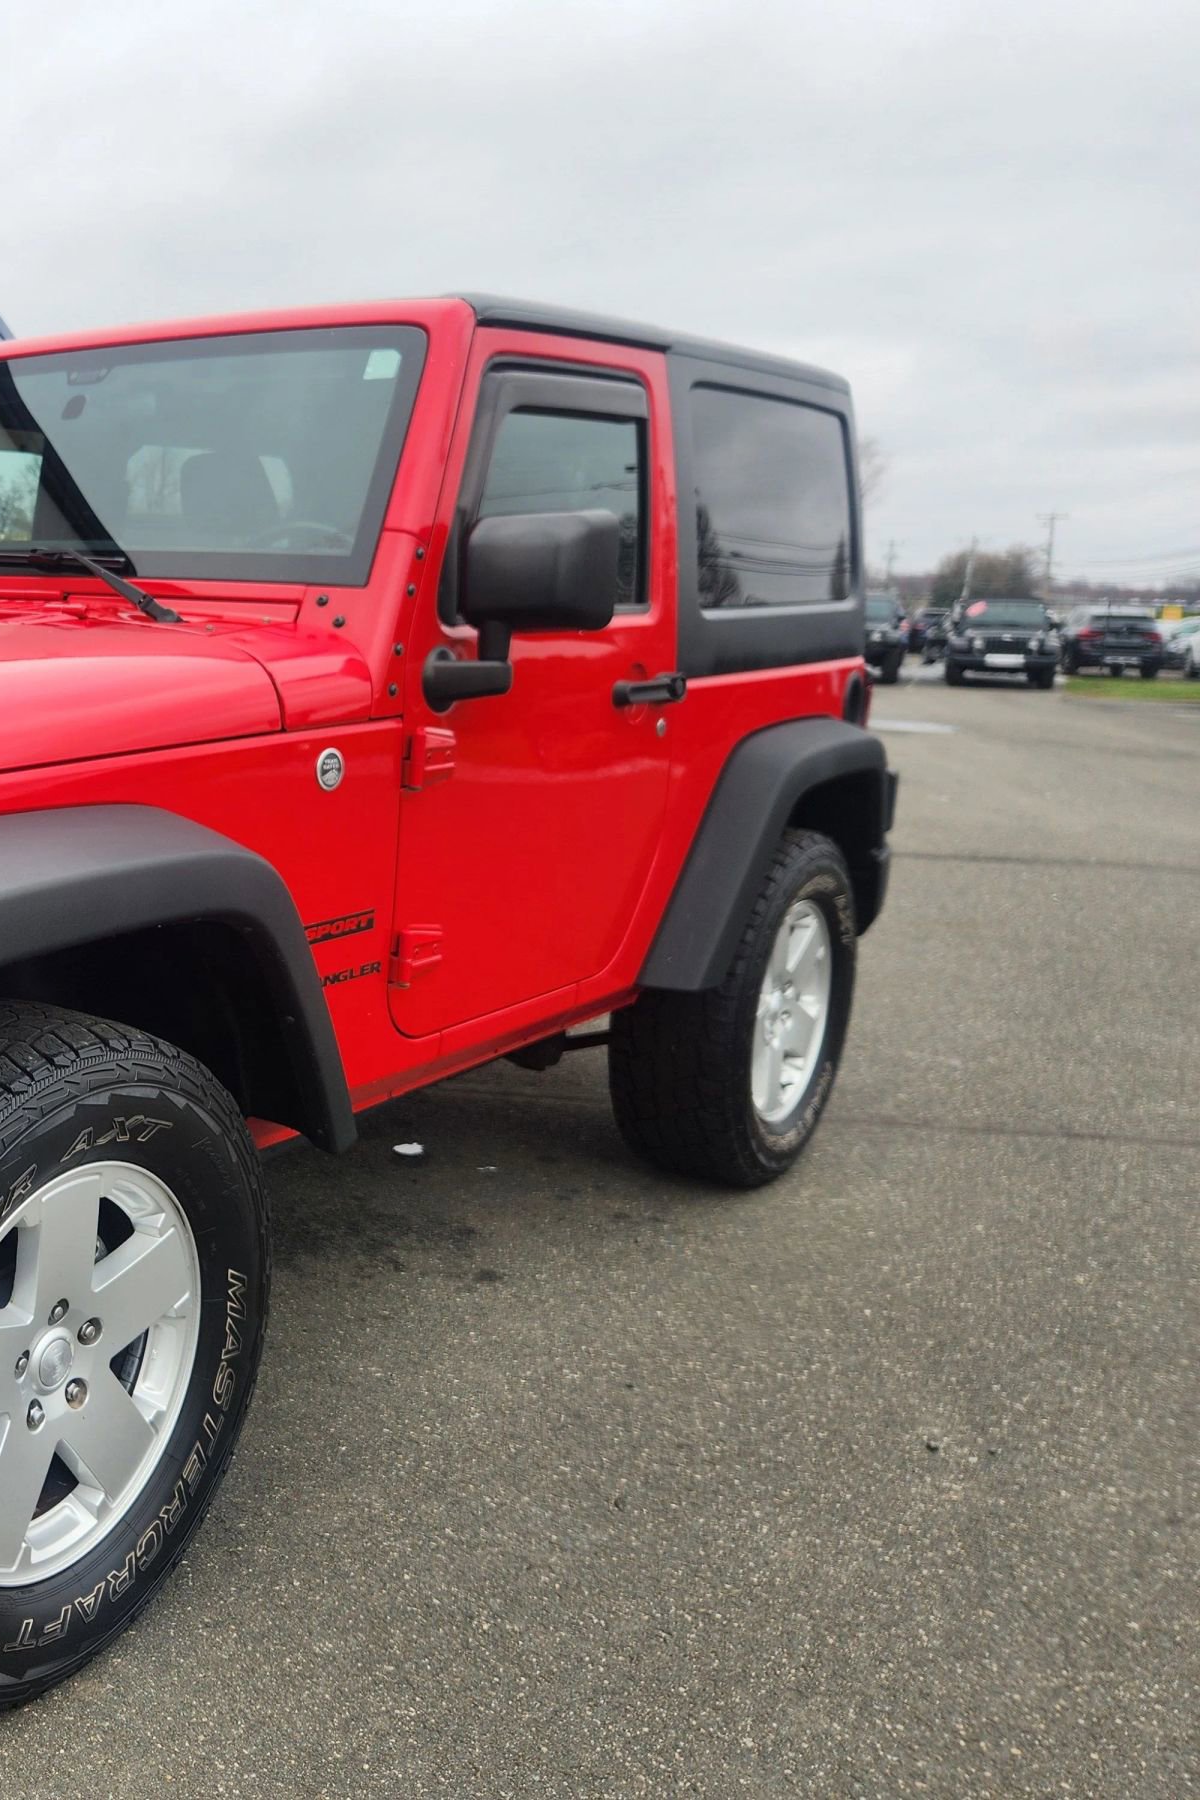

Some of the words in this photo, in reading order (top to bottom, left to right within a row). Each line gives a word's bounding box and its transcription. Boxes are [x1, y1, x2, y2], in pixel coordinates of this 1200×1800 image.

[305, 914, 374, 941] SPORT
[321, 961, 382, 987] NGLER
[60, 1114, 173, 1163] AXT
[2, 1267, 248, 1654] MASTERCRAFT
